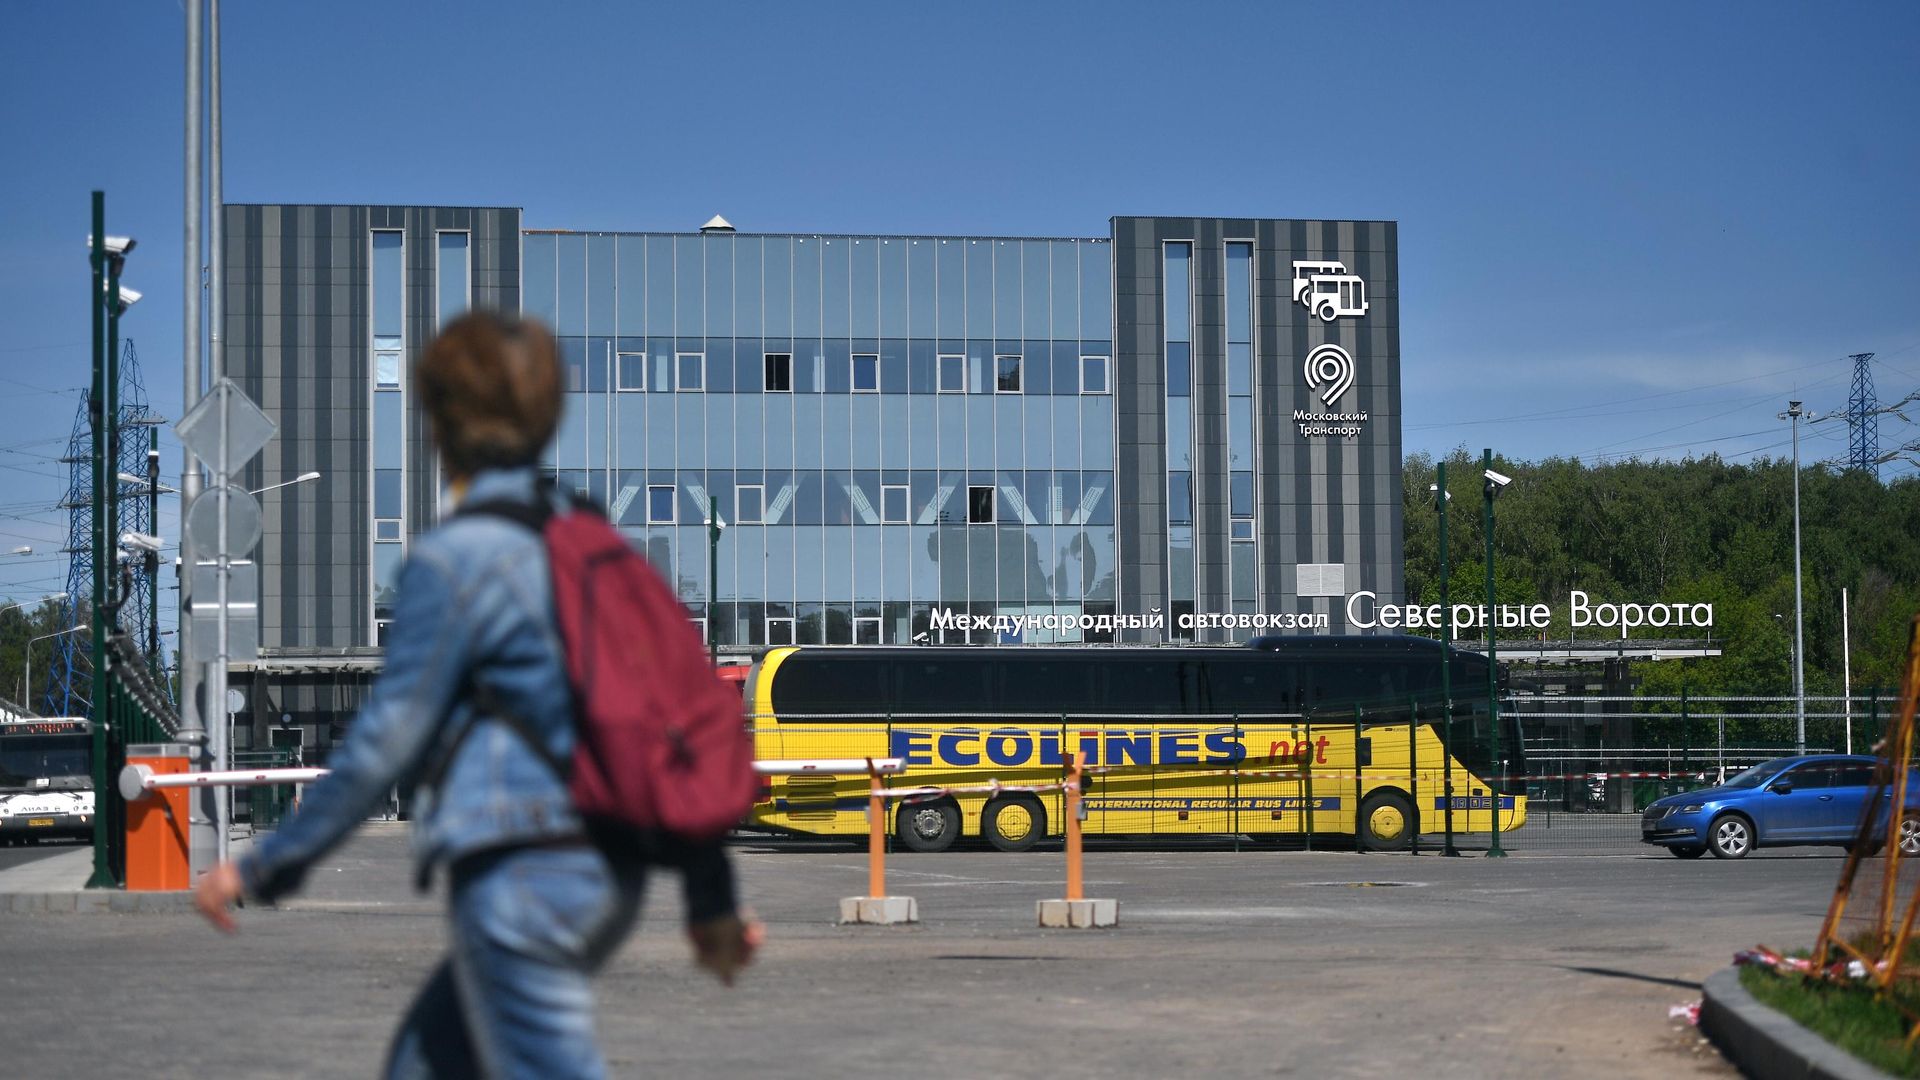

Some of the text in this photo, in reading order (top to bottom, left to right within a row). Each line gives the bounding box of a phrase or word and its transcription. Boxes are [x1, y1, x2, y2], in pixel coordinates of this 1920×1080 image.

[1293, 409, 1368, 421] Московский
[1298, 423, 1362, 438] Транспорт
[929, 590, 1714, 639] Международный автовокзал Северные Ворота
[1084, 799, 1187, 809] INTERNATIONAL
[1254, 799, 1282, 809] BUS
